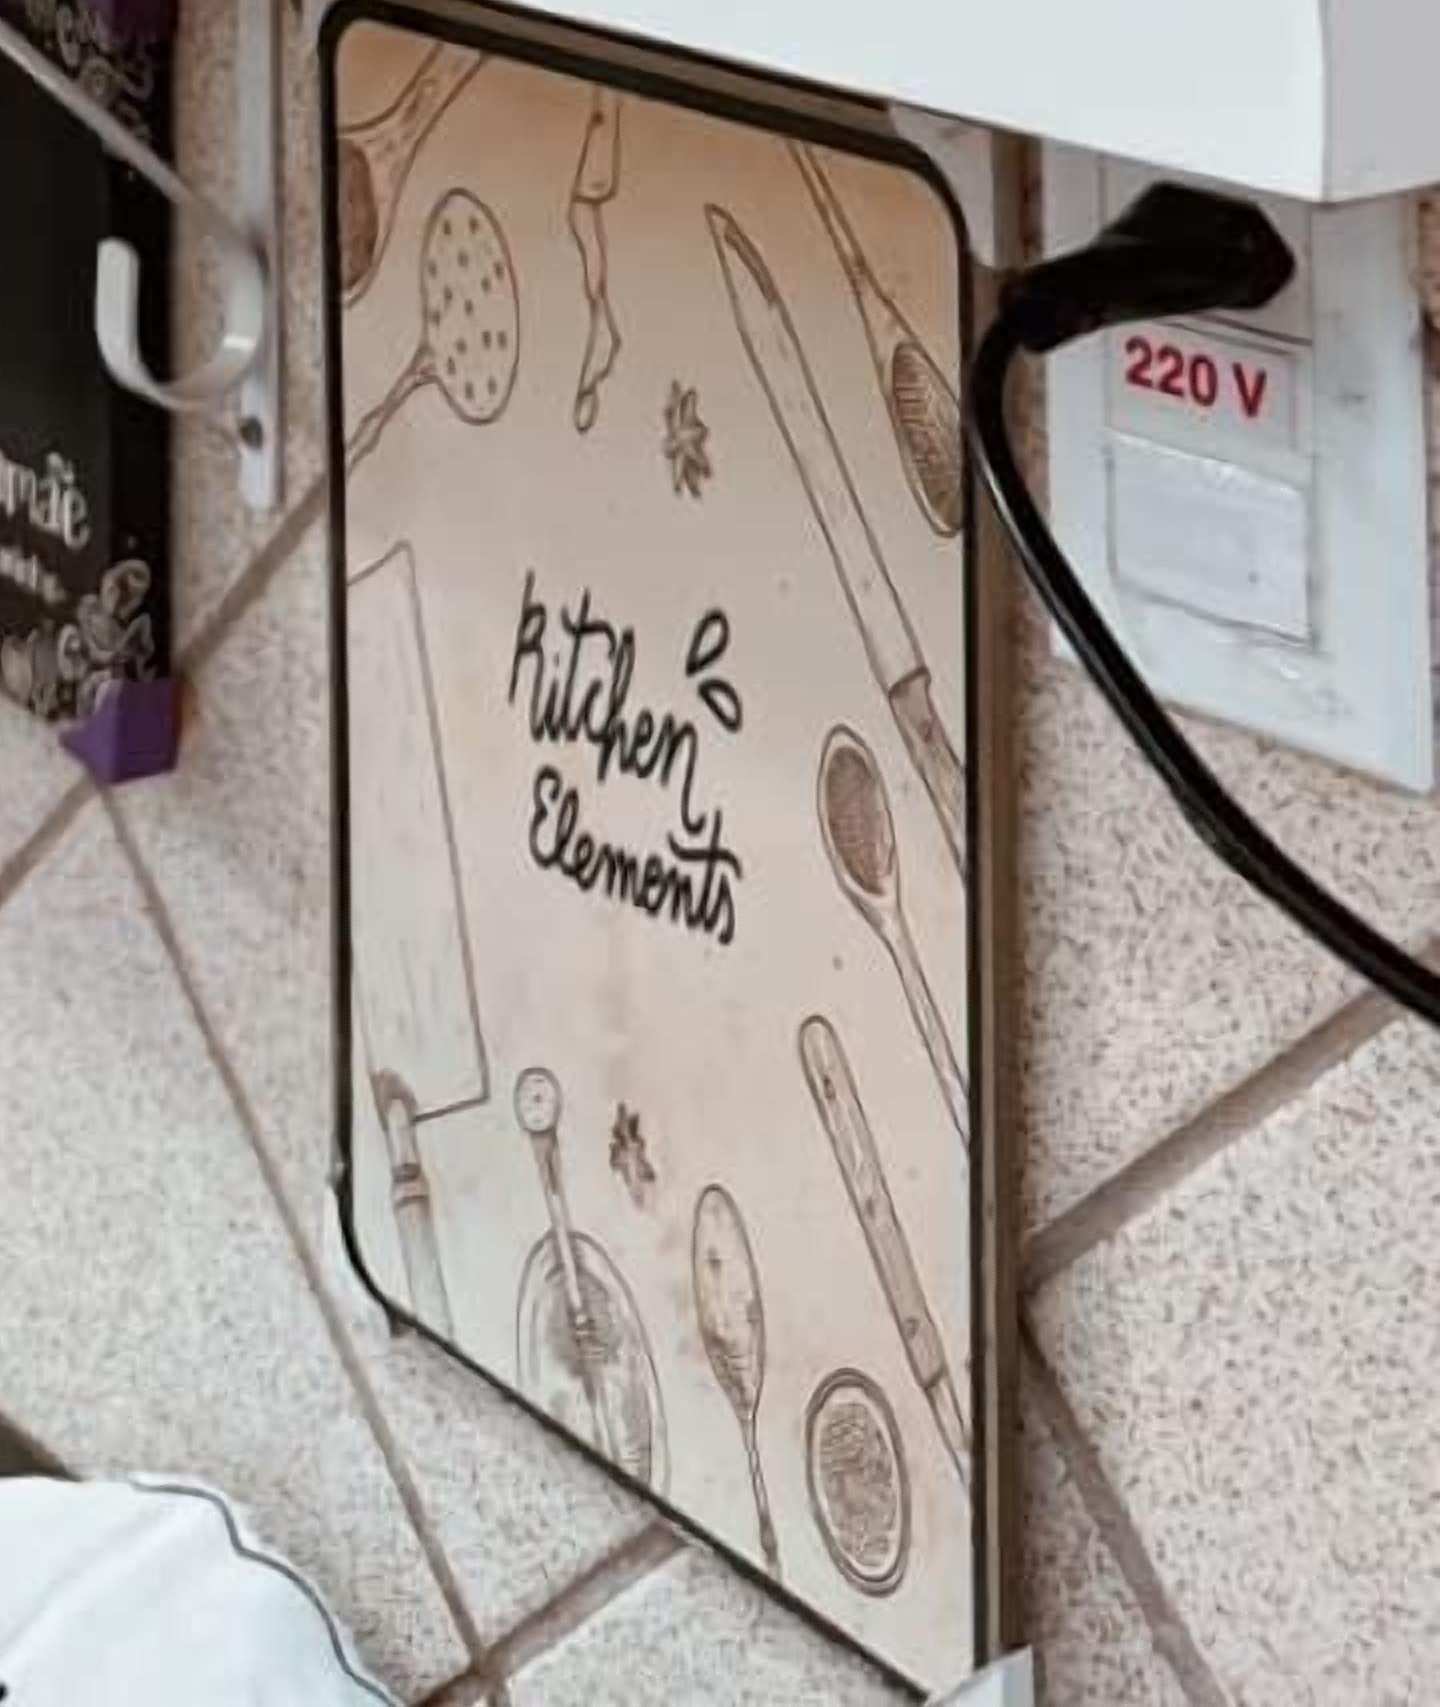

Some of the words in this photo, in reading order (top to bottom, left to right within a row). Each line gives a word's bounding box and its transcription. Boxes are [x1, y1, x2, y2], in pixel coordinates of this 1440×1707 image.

[1125, 336, 1218, 407] 220
[1232, 361, 1268, 419] V
[509, 568, 707, 836] Kitchen
[529, 763, 743, 945] Elements
